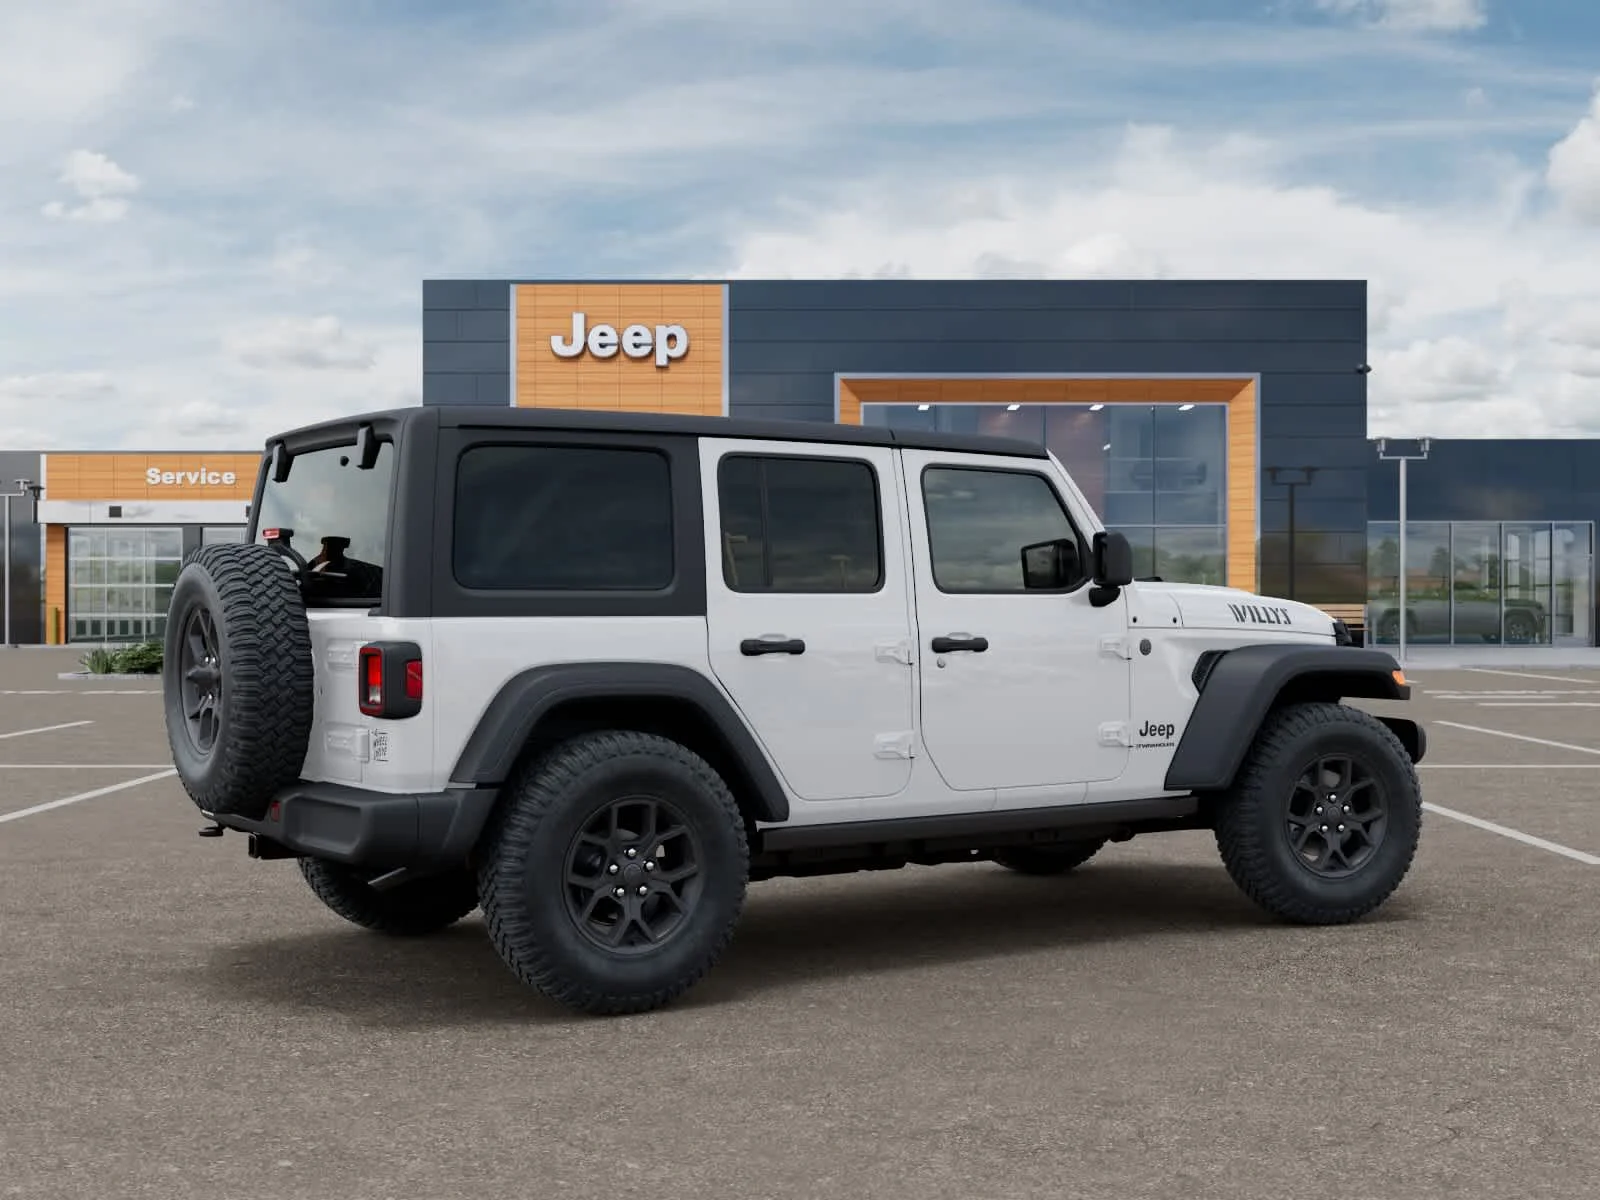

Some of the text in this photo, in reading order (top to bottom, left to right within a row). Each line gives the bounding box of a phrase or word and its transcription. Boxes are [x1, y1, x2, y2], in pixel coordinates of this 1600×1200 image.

[550, 312, 689, 367] Jeep
[146, 466, 236, 485] Service
[1139, 720, 1175, 739] Jeep
